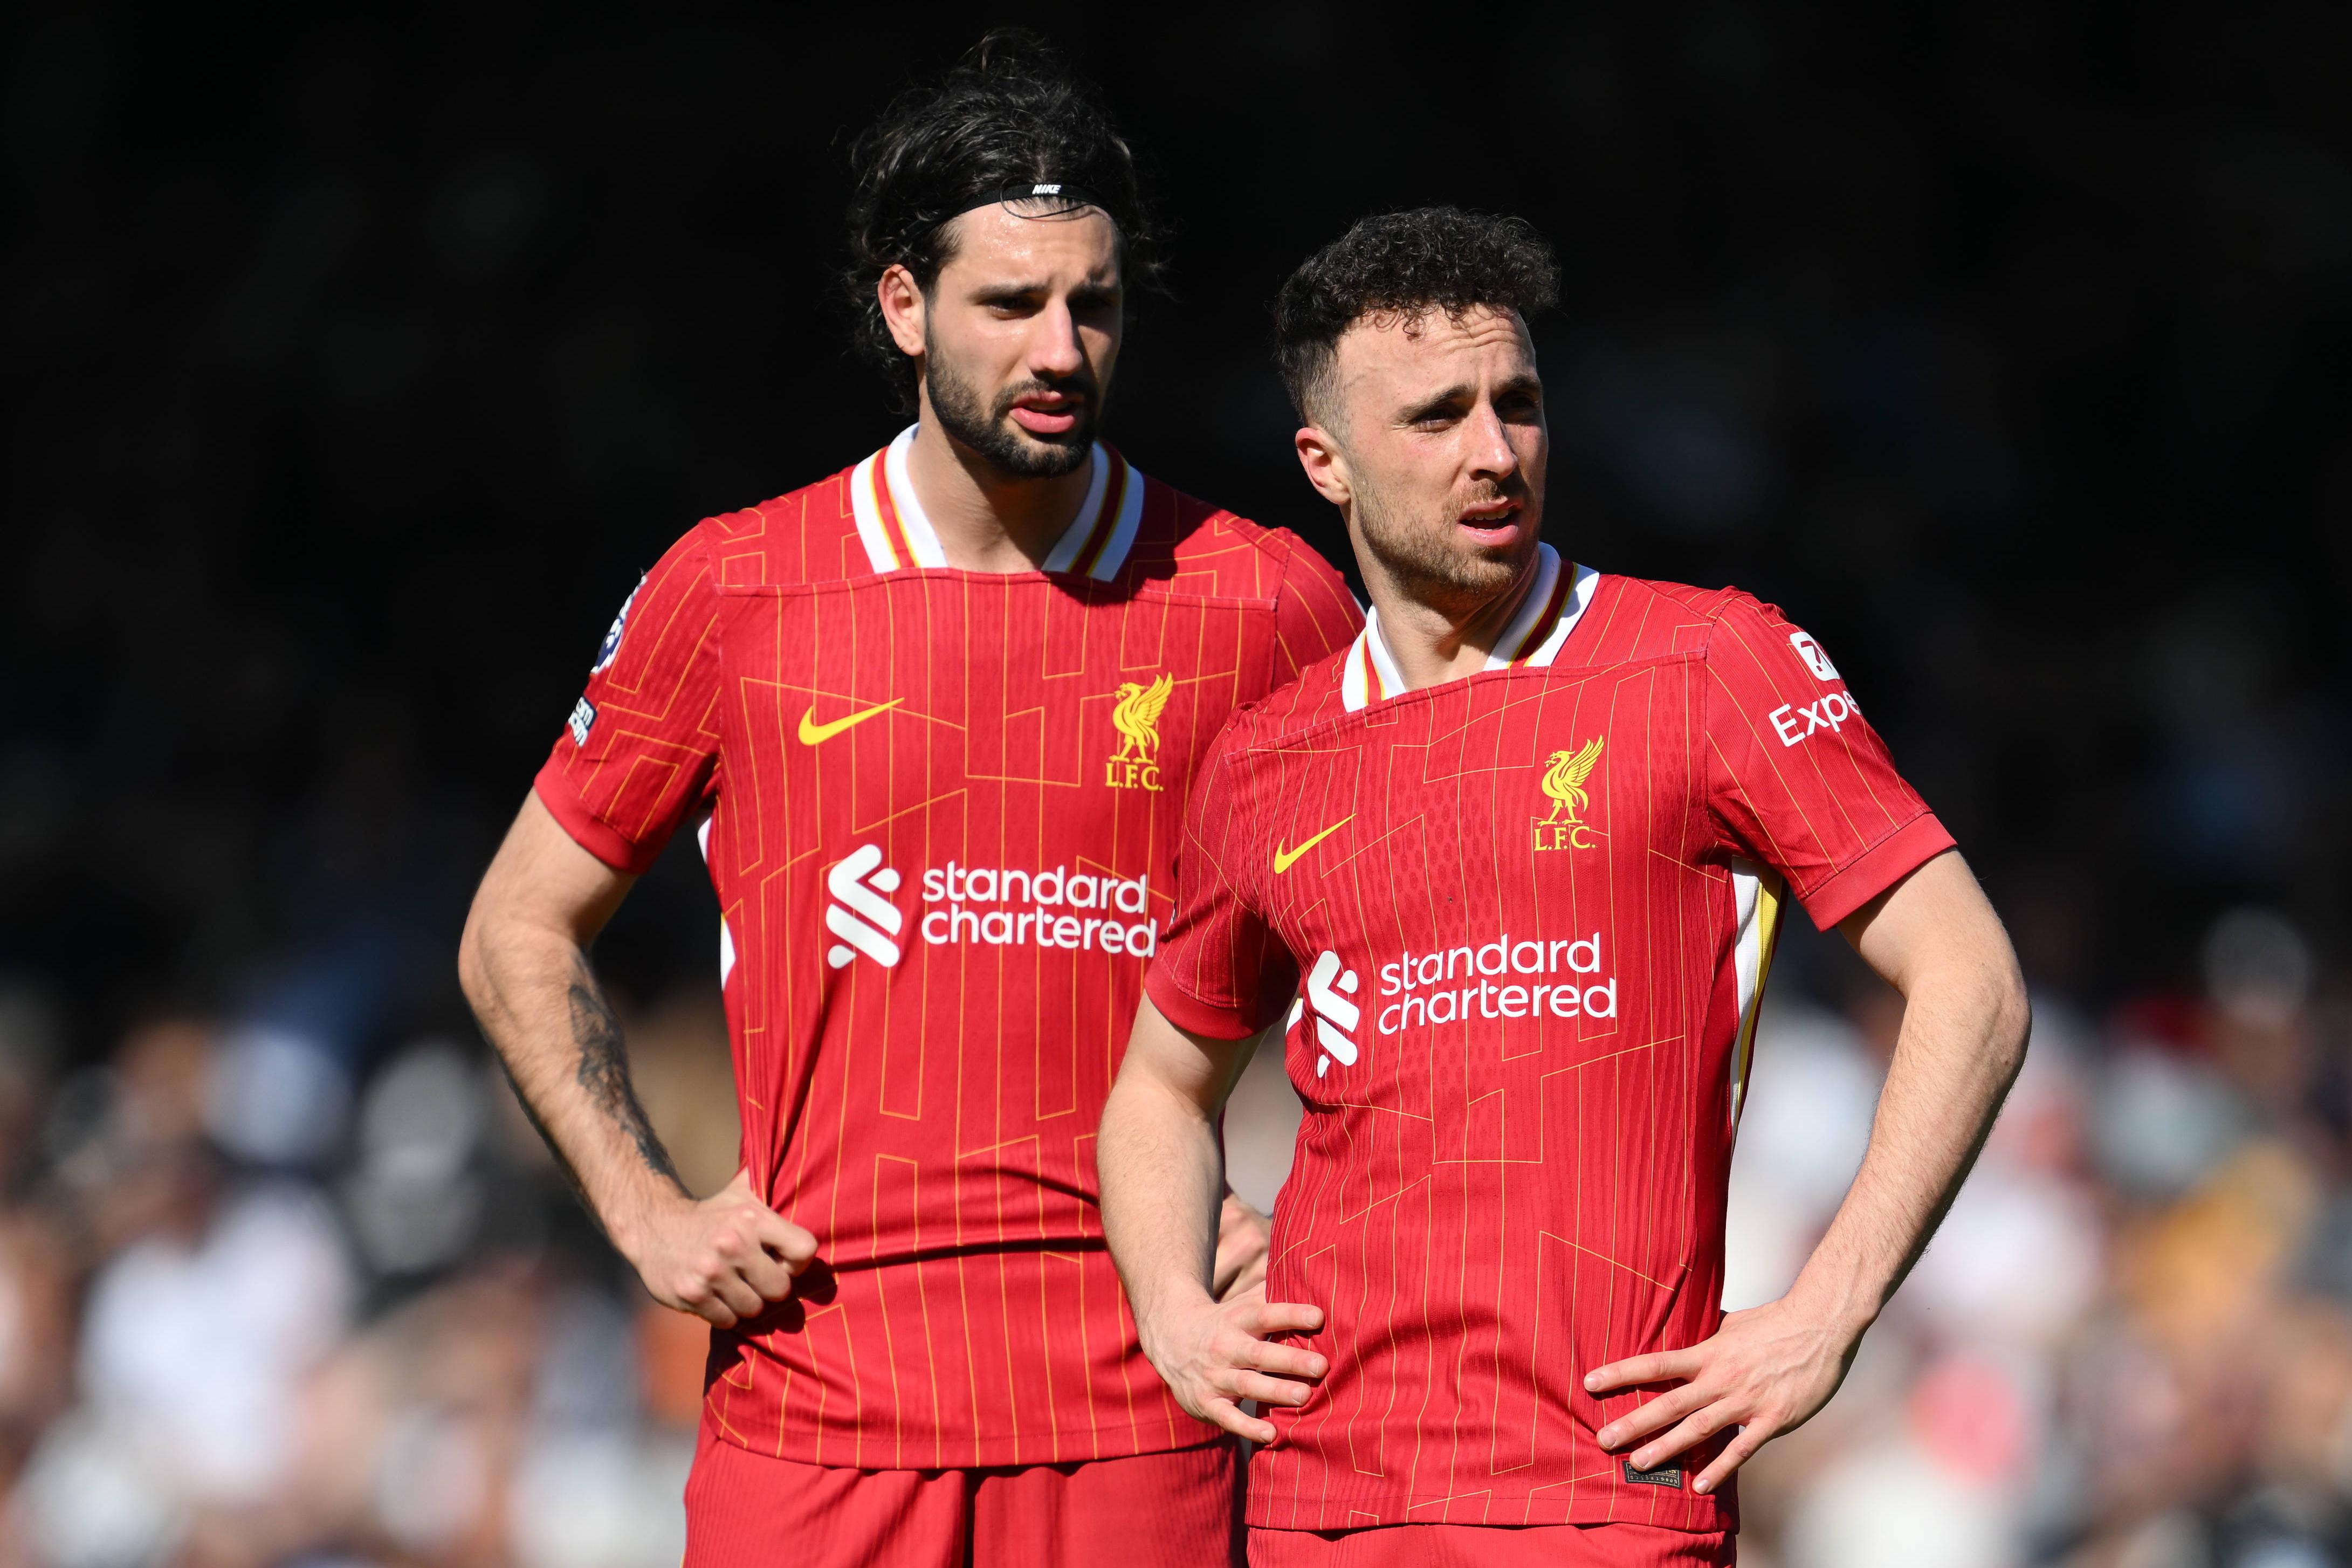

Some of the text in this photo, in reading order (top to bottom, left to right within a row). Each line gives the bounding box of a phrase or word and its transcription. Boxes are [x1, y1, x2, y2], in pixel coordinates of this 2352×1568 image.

[1032, 184, 1061, 194] NIKE
[1534, 826, 1596, 851] L.F.C.
[922, 860, 1147, 914] standard
[921, 903, 1158, 958] chartered
[1379, 931, 1600, 996] standard
[1378, 978, 1617, 1035] chartered
